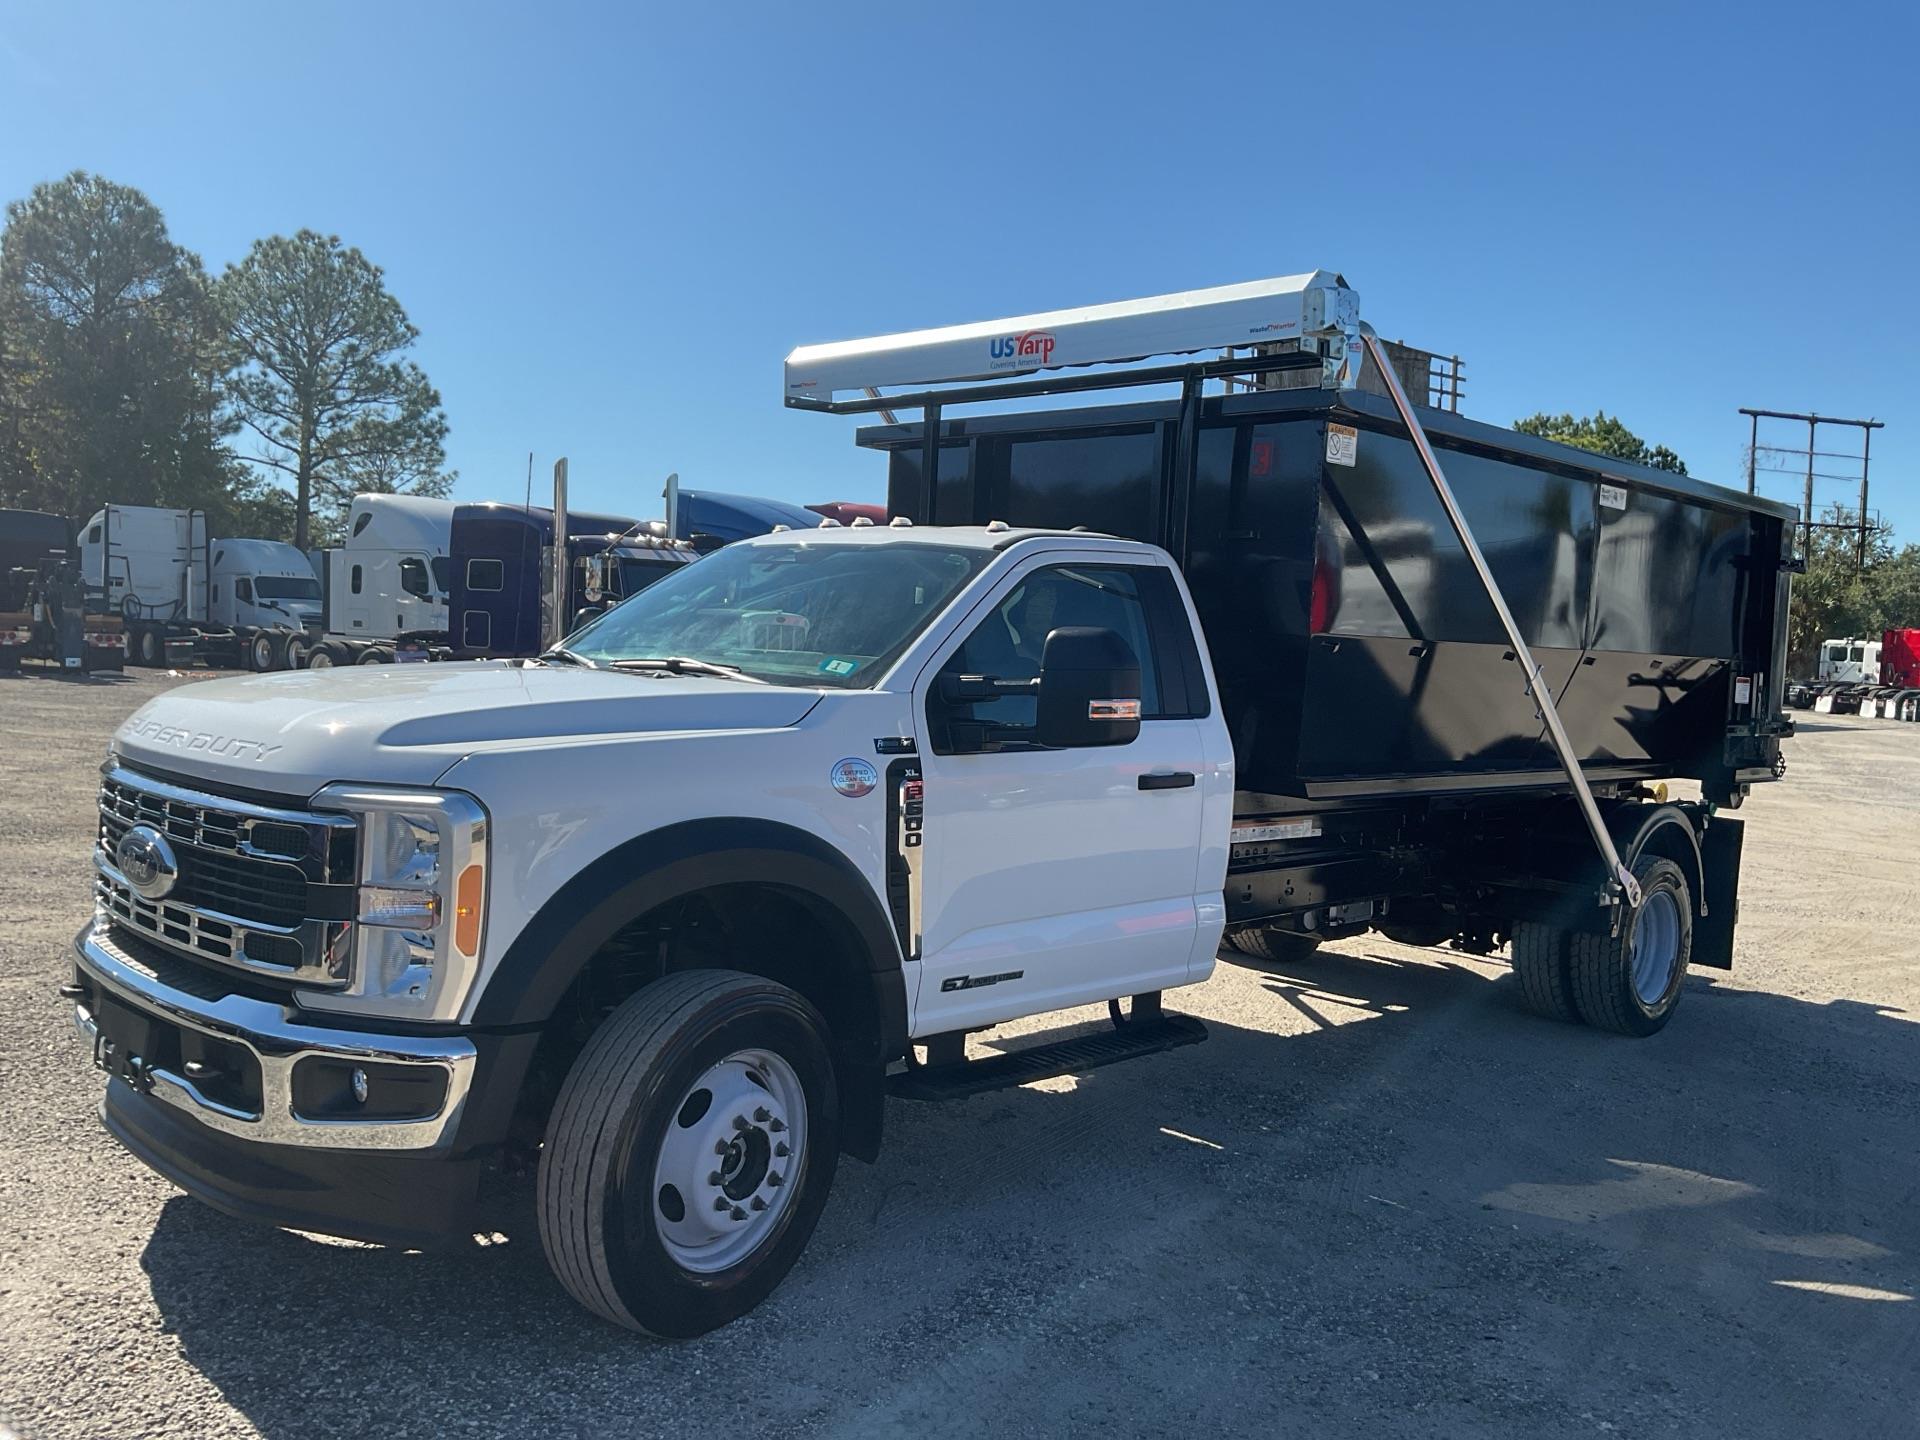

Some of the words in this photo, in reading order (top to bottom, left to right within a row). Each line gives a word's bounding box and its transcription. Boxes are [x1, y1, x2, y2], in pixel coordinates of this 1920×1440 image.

[123, 718, 191, 747] SUPER
[187, 733, 283, 761] DUTY
[905, 769, 919, 777] XL
